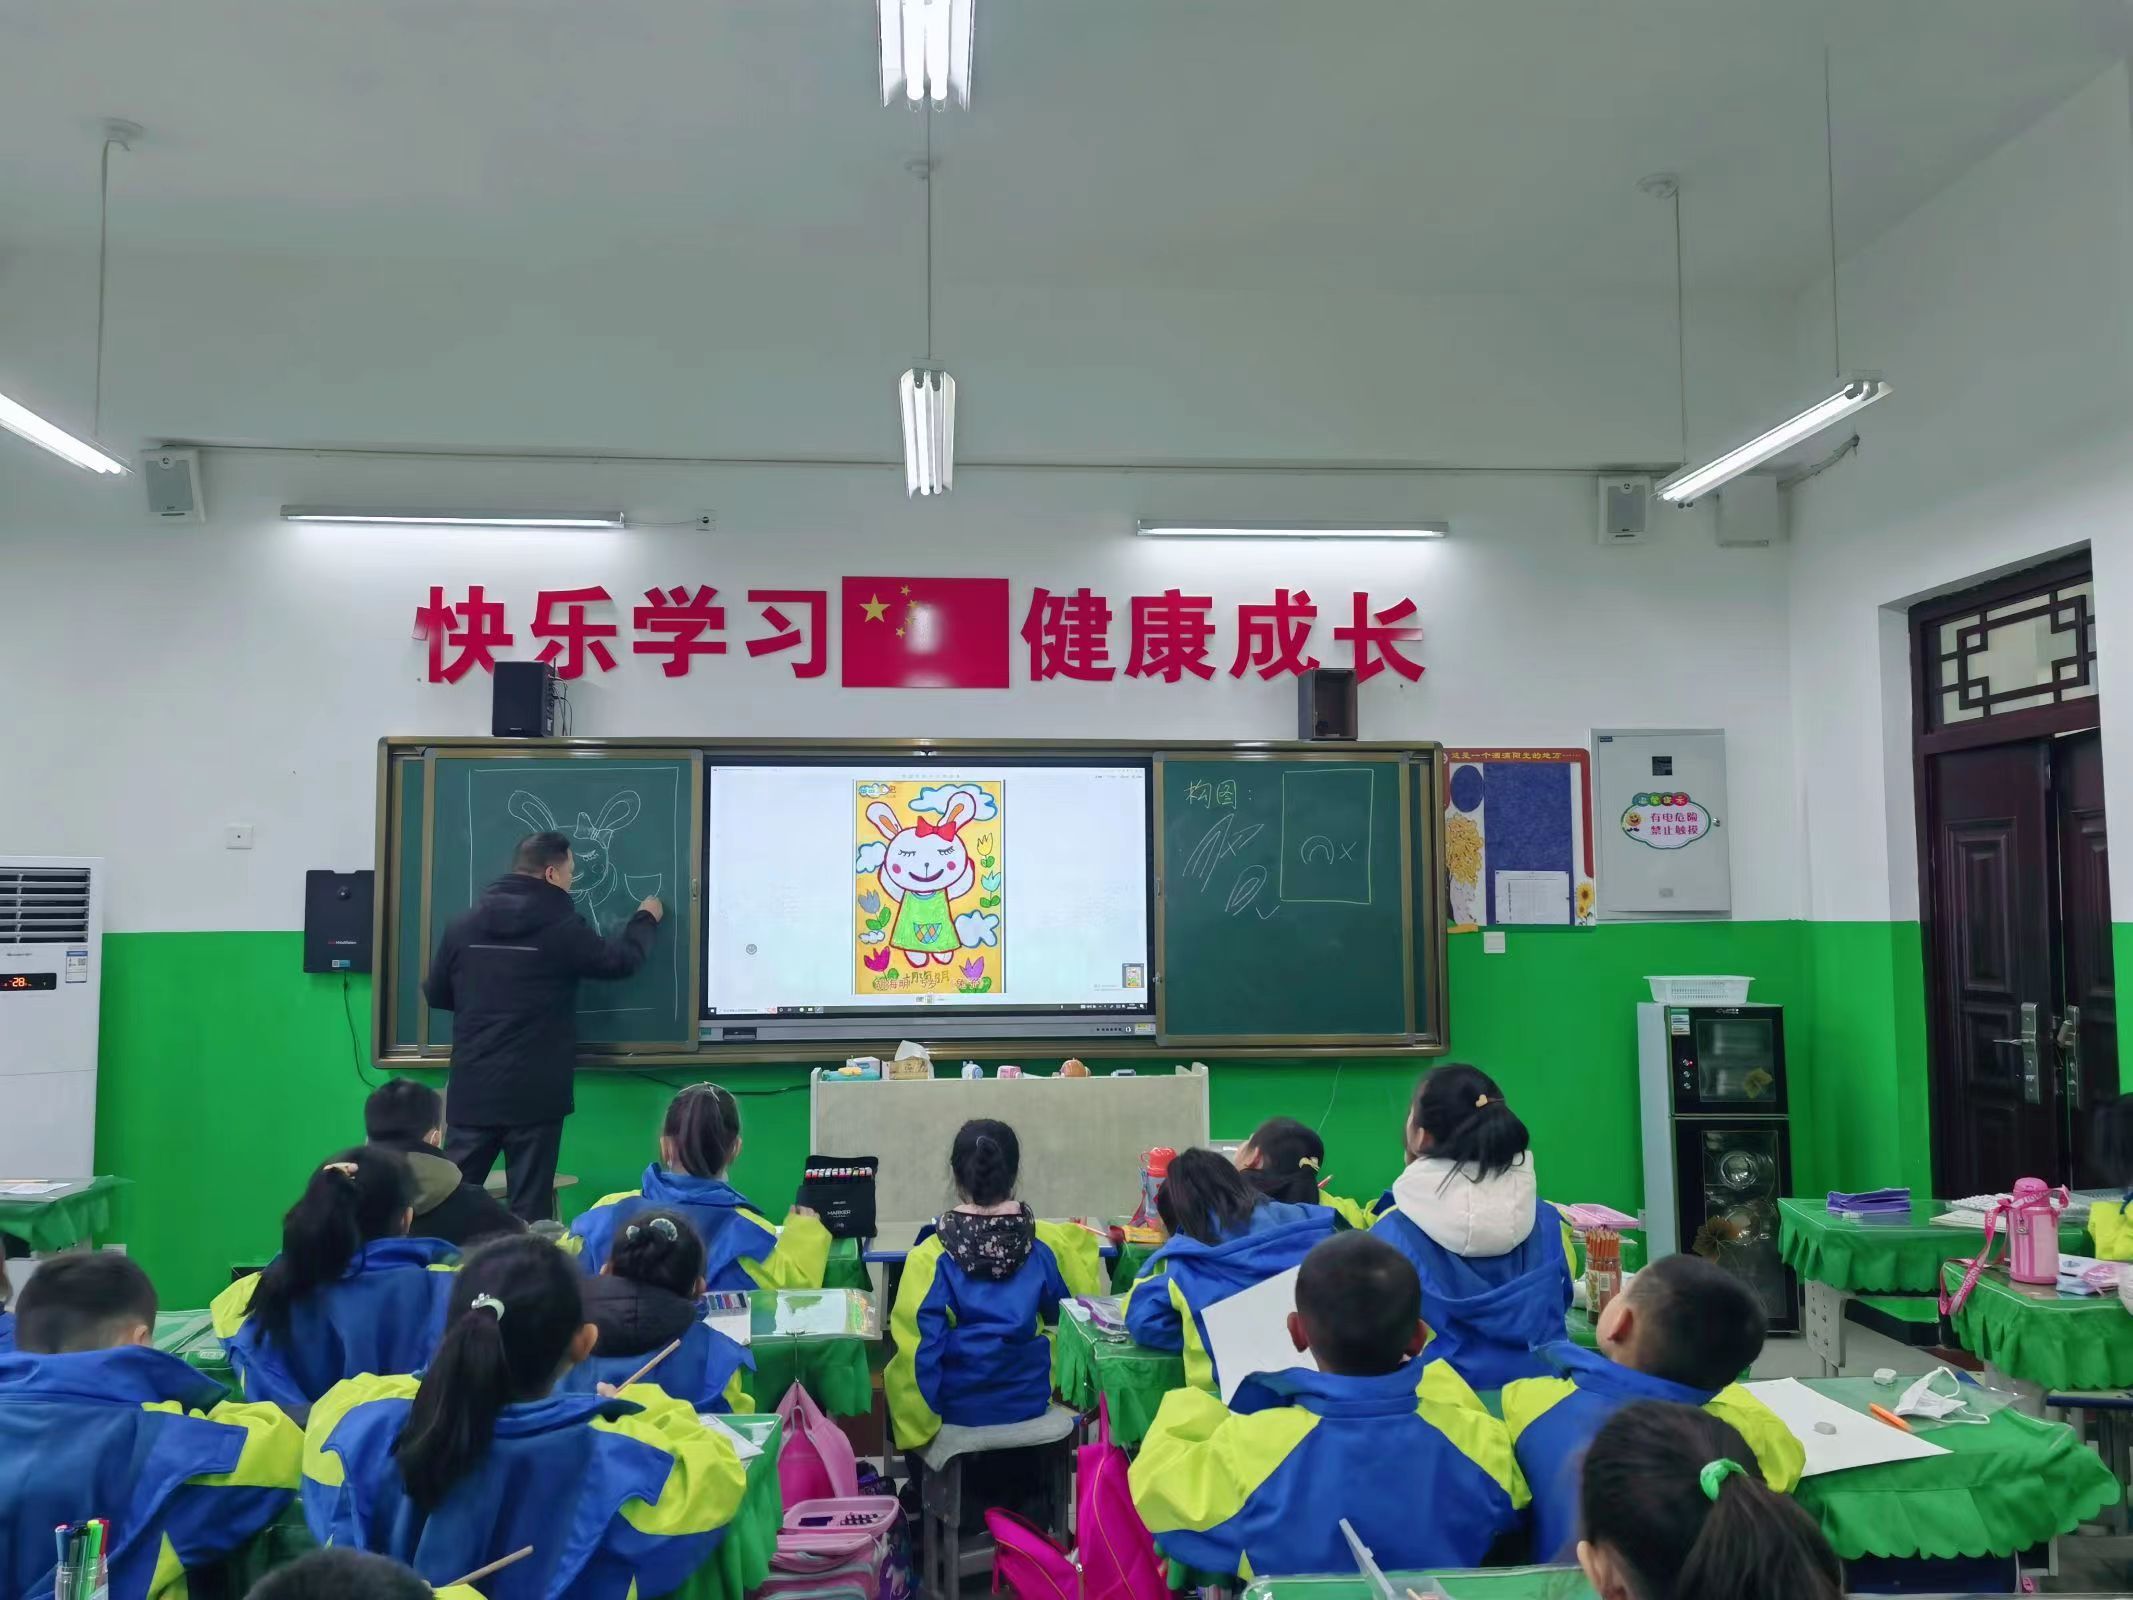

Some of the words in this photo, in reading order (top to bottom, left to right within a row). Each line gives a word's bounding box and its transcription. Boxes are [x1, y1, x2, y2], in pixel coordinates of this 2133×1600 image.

[413, 585, 827, 684] 快乐学习
[1020, 587, 1425, 684] 健康成长
[1651, 812, 1698, 823] 有电危险
[1651, 825, 1698, 835] 禁止触摸
[12, 977, 26, 987] 28
